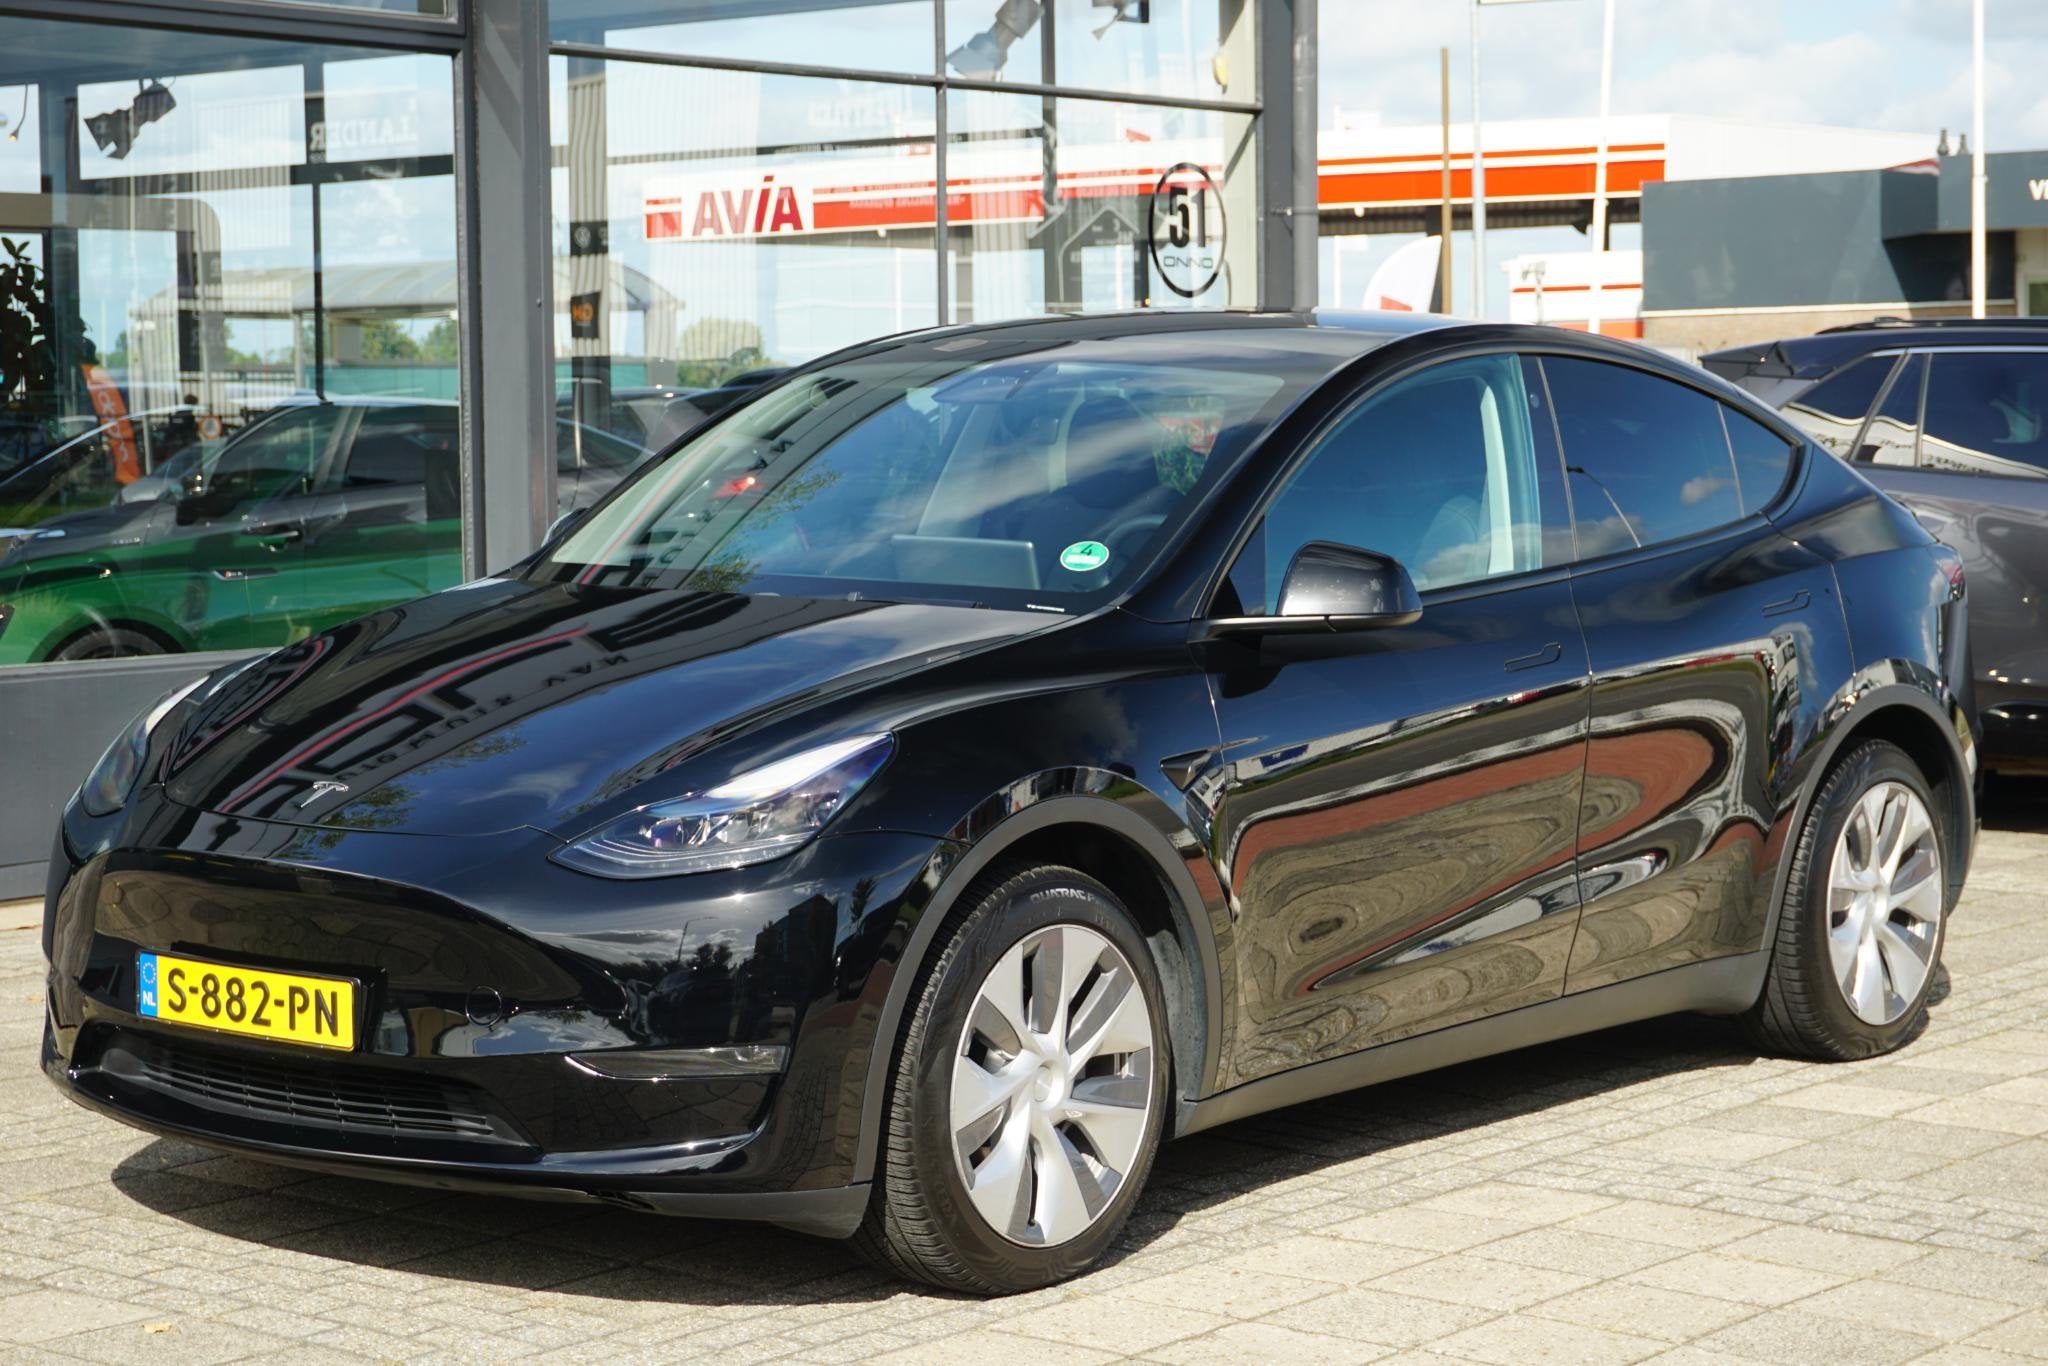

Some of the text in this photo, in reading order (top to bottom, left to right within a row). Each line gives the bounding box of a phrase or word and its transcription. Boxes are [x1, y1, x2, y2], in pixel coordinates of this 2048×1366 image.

[1169, 186, 1206, 248] 51
[1080, 543, 1094, 556] 4
[143, 967, 339, 1038] NL S-882-PN
